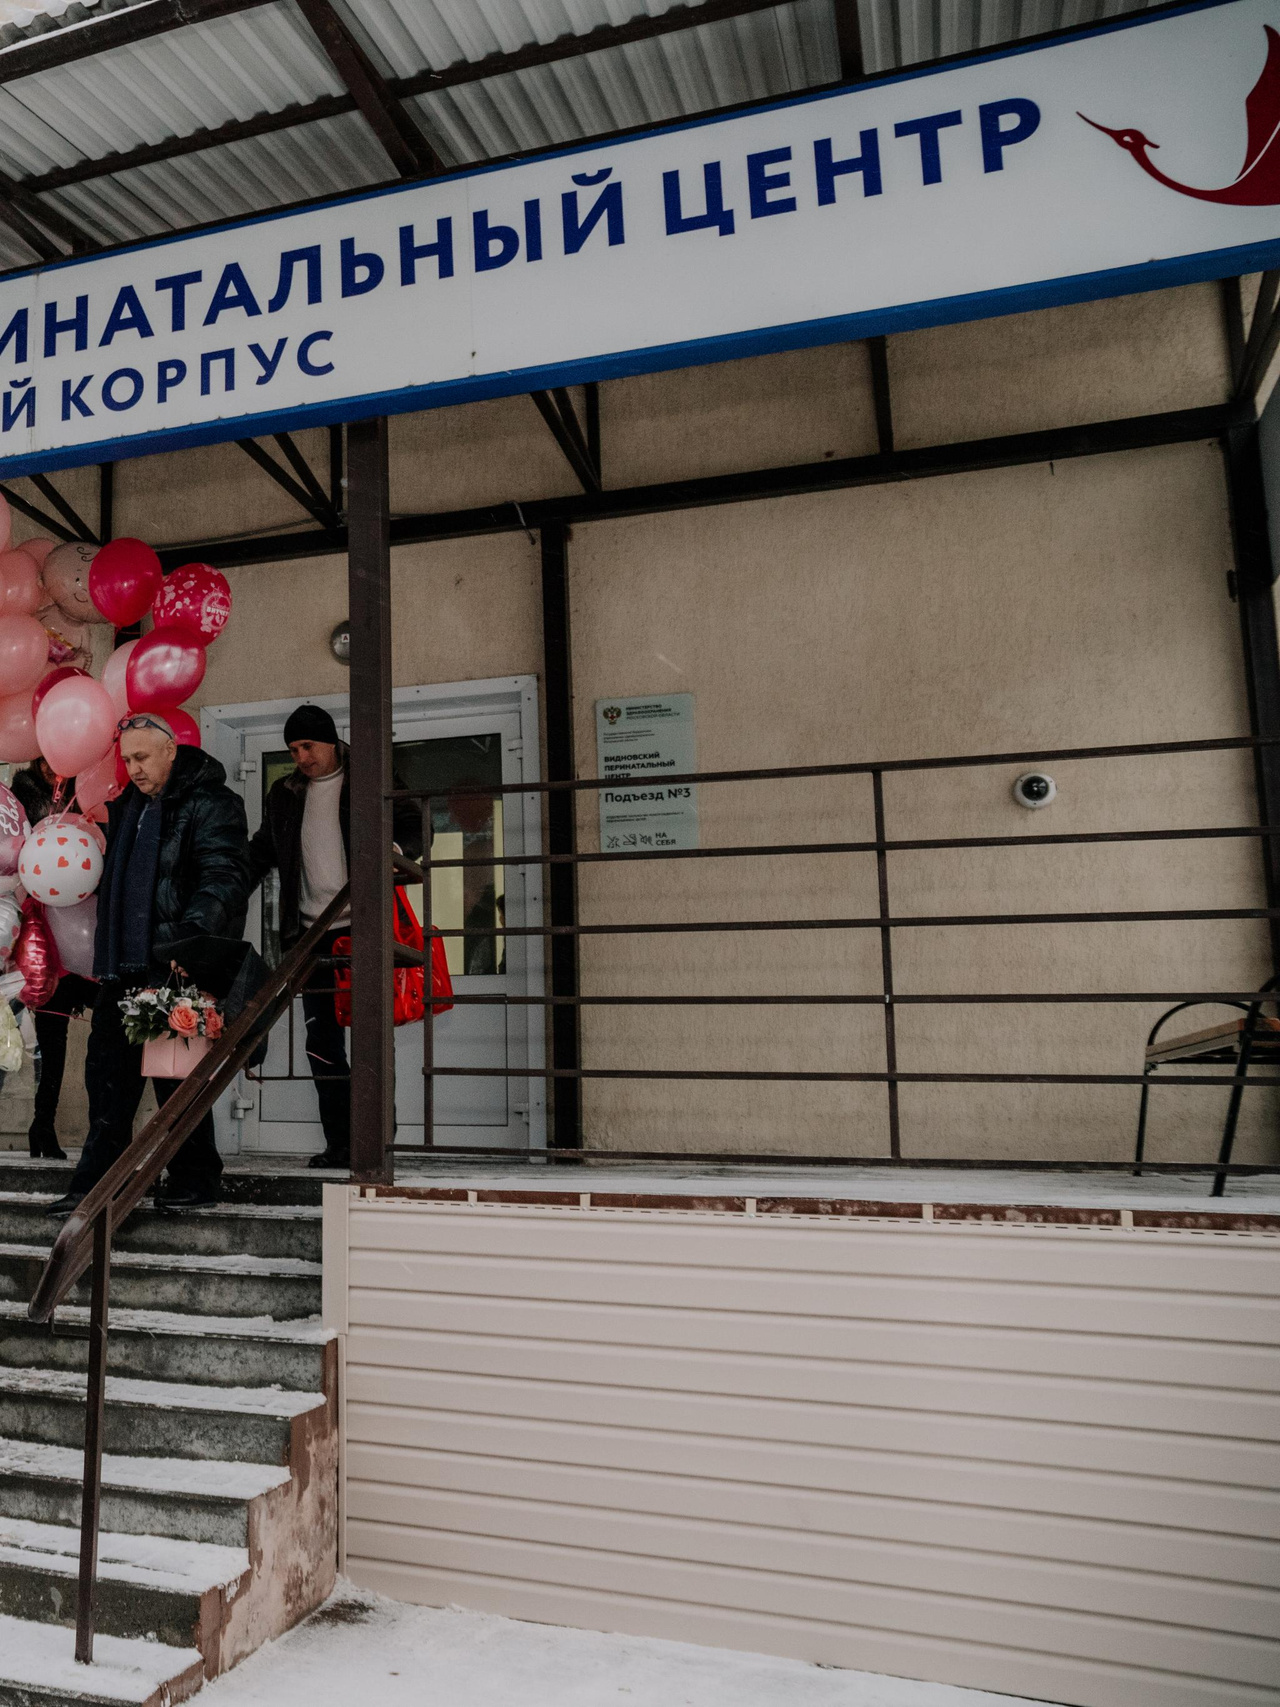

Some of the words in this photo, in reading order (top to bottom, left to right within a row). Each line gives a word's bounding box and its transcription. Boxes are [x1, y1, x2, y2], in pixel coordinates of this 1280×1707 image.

[662, 97, 1041, 237] ЦЕНТР
[61, 330, 335, 421] КОРПУС
[604, 751, 660, 763] ВИДНОВСКИЙ
[604, 759, 676, 771] ПЕРИНАТАЛЬНЫЙ
[605, 791, 664, 803] Подъезд
[668, 787, 691, 798] №3
[655, 838, 677, 846] СЕБЯ
